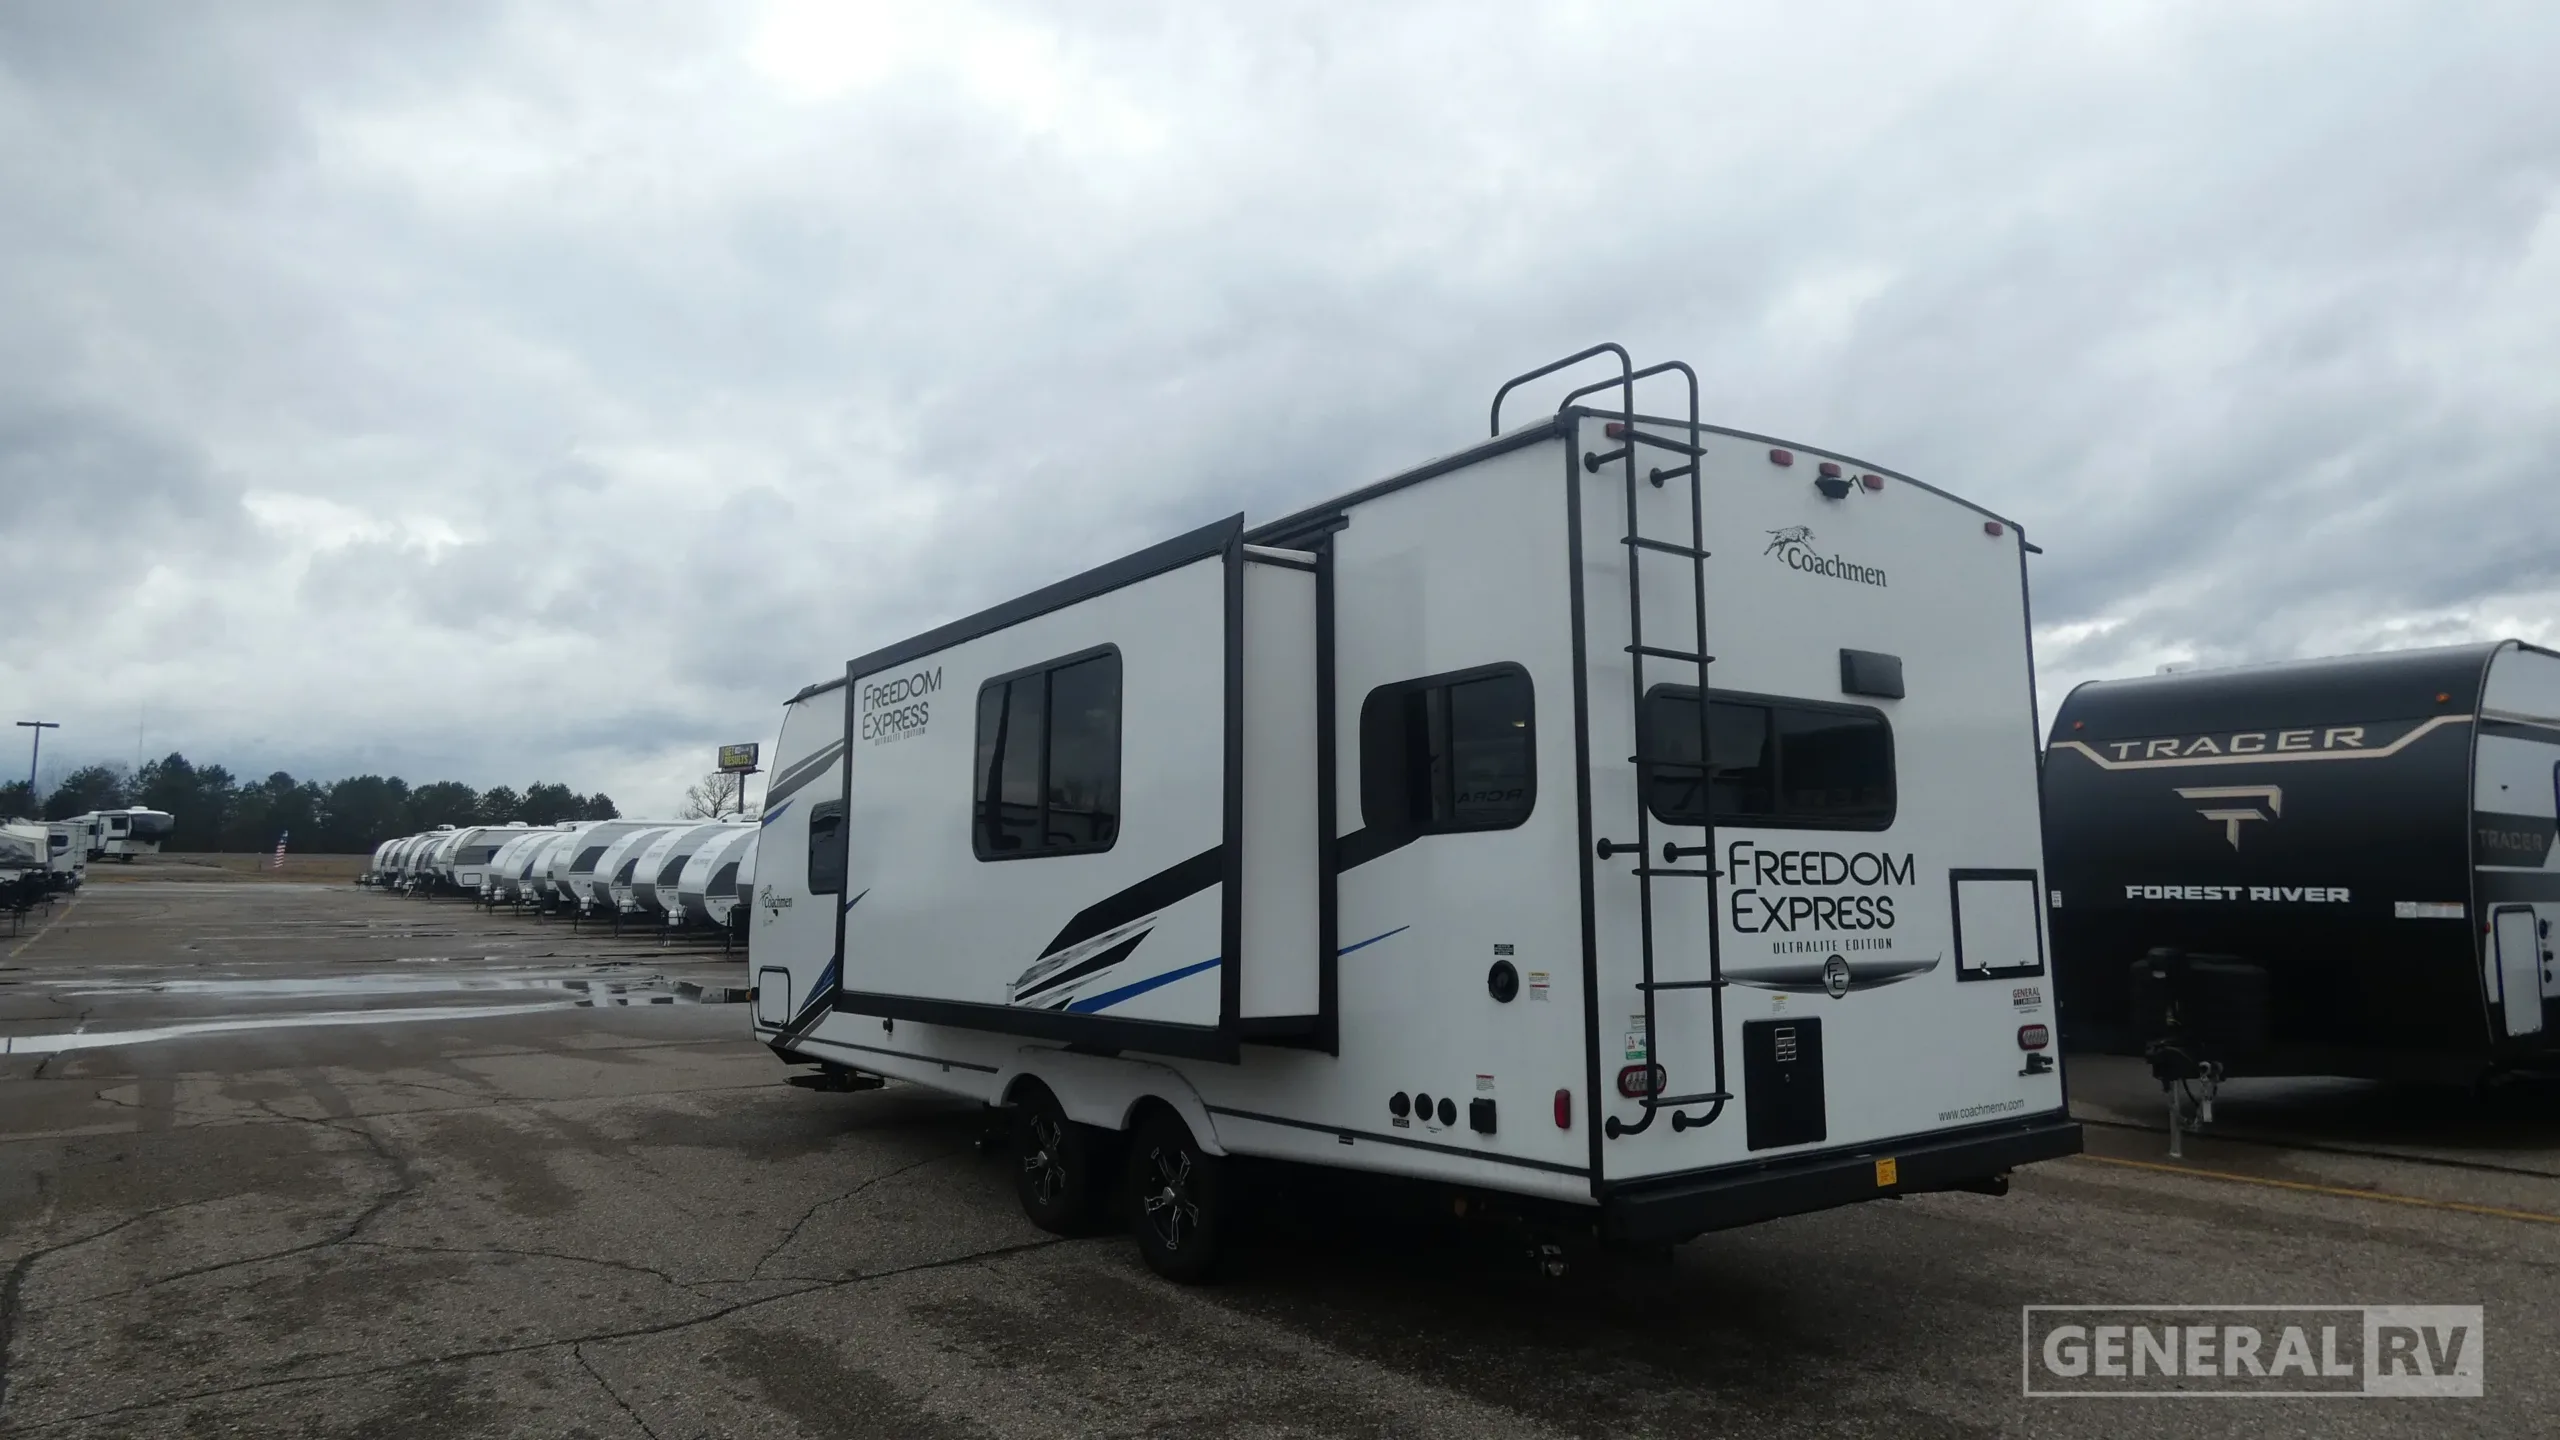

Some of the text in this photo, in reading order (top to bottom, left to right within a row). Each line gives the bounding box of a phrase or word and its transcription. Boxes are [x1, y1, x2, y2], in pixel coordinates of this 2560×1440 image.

[1787, 547, 1887, 587] Coachmen
[2110, 727, 2365, 760] TRACER
[2478, 829, 2543, 852] TRACER
[1729, 841, 1915, 886] FREEDOM
[2125, 885, 2350, 903] FOREST RIVER
[1731, 889, 1895, 933] EXPRESS
[1773, 938, 1892, 955] ULTRALITE EDITION
[2013, 987, 2040, 998] GENERAL
[1938, 1098, 2025, 1122] www.coachmenrv.com
